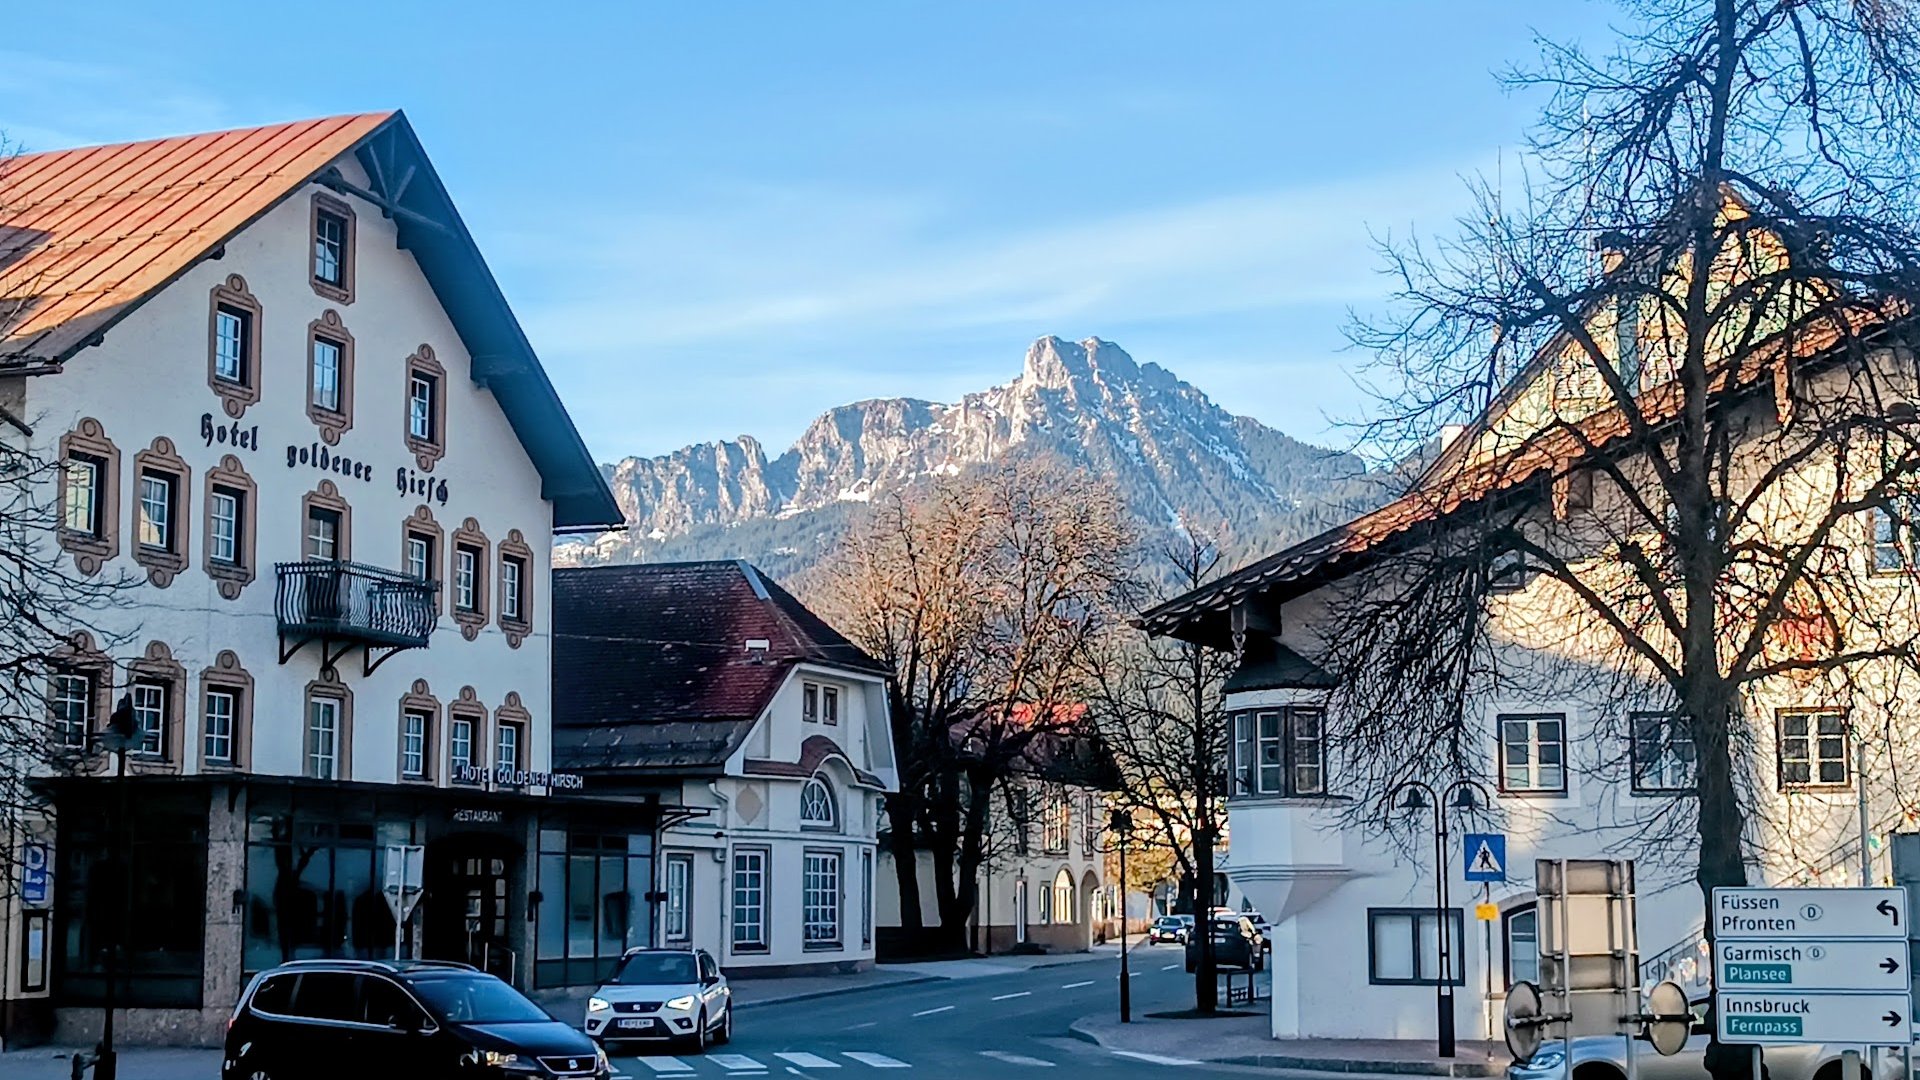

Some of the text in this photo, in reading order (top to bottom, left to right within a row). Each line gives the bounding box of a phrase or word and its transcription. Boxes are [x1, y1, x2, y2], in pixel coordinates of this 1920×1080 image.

[201, 412, 449, 507] Hotel goldener Hirsch
[498, 769, 548, 786] GOLDENER
[551, 774, 584, 789] HIRSCH
[1722, 895, 1779, 910] Füssen
[1807, 907, 1816, 919] D
[1722, 916, 1796, 931] Pfronten
[1723, 945, 1801, 961] Garmisch
[1729, 966, 1787, 981] Plansee
[1726, 998, 1810, 1013] Innsbruck
[1731, 1019, 1797, 1035] Fernpass
